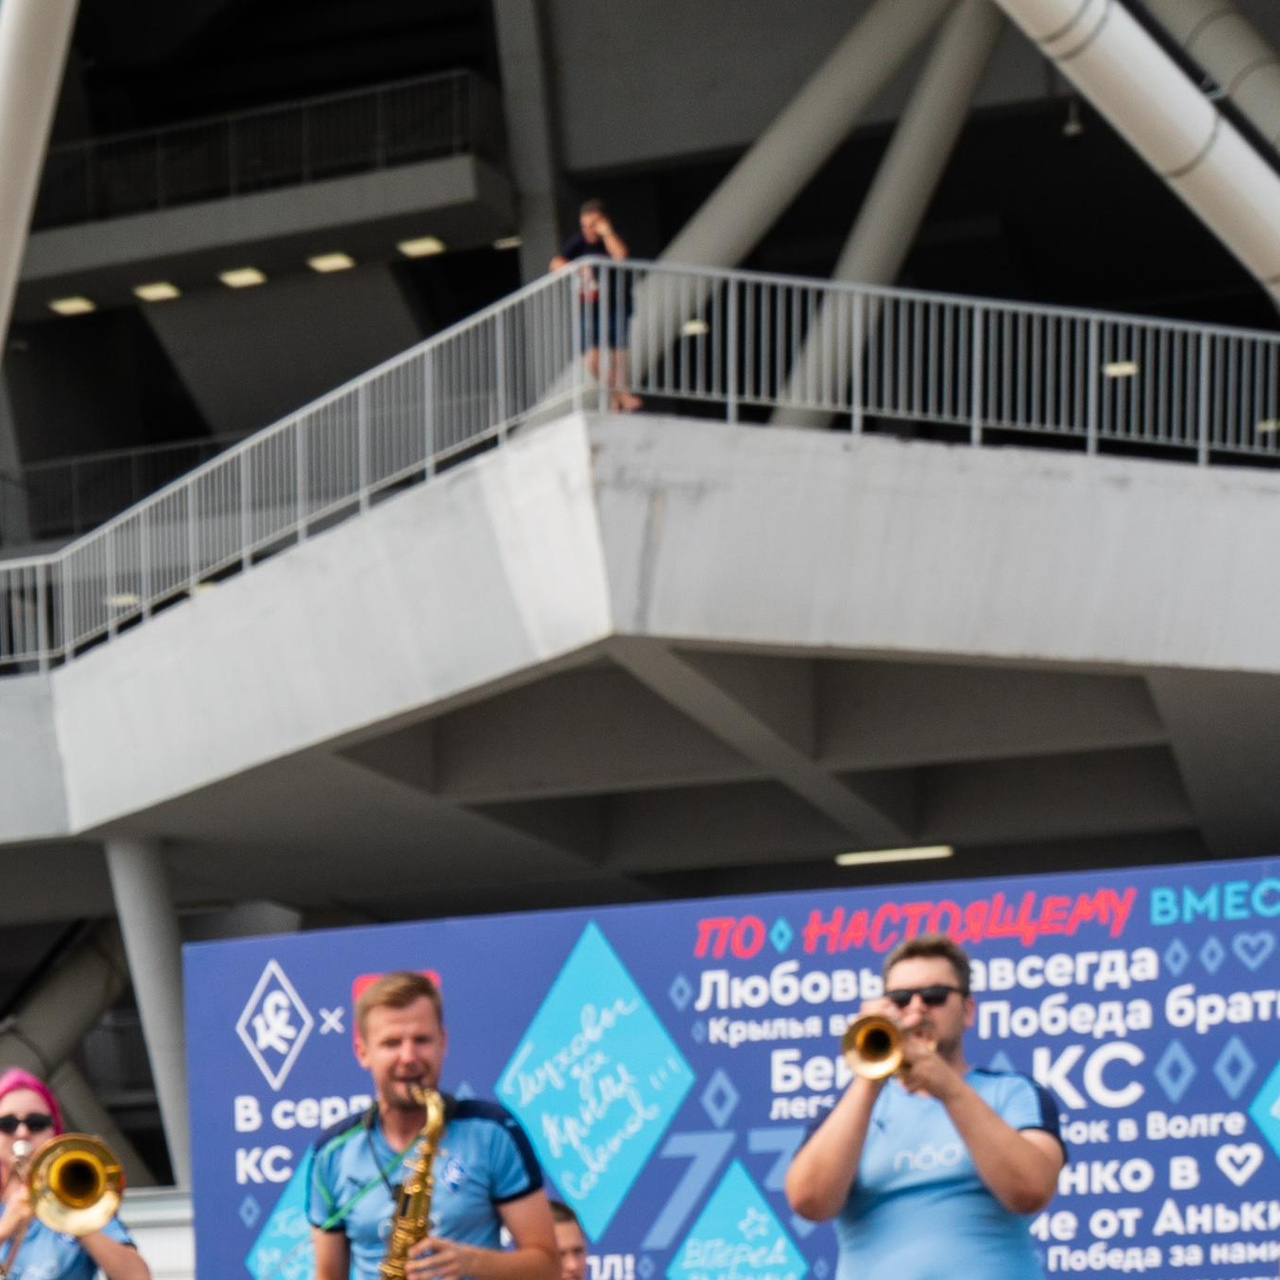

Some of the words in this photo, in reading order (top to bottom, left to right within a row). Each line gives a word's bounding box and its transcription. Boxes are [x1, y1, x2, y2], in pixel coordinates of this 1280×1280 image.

[694, 915, 766, 960] ПО
[802, 886, 1137, 955] НАСТОЯЩЕМУ
[1150, 877, 1280, 926] ВМЕС
[695, 959, 884, 1012] Любовь
[978, 991, 1153, 1040] Победа
[1165, 983, 1280, 1035] брат
[708, 1016, 823, 1048] Крылья
[1032, 1040, 1146, 1110] КС
[234, 1095, 262, 1132] В
[1058, 1113, 1110, 1145] ок
[1117, 1118, 1139, 1143] в
[1146, 1110, 1247, 1141] Волге
[235, 1145, 293, 1185] КС
[1088, 1207, 1144, 1240] от
[1047, 1241, 1163, 1273] Победа
[1169, 1244, 1204, 1268] за
